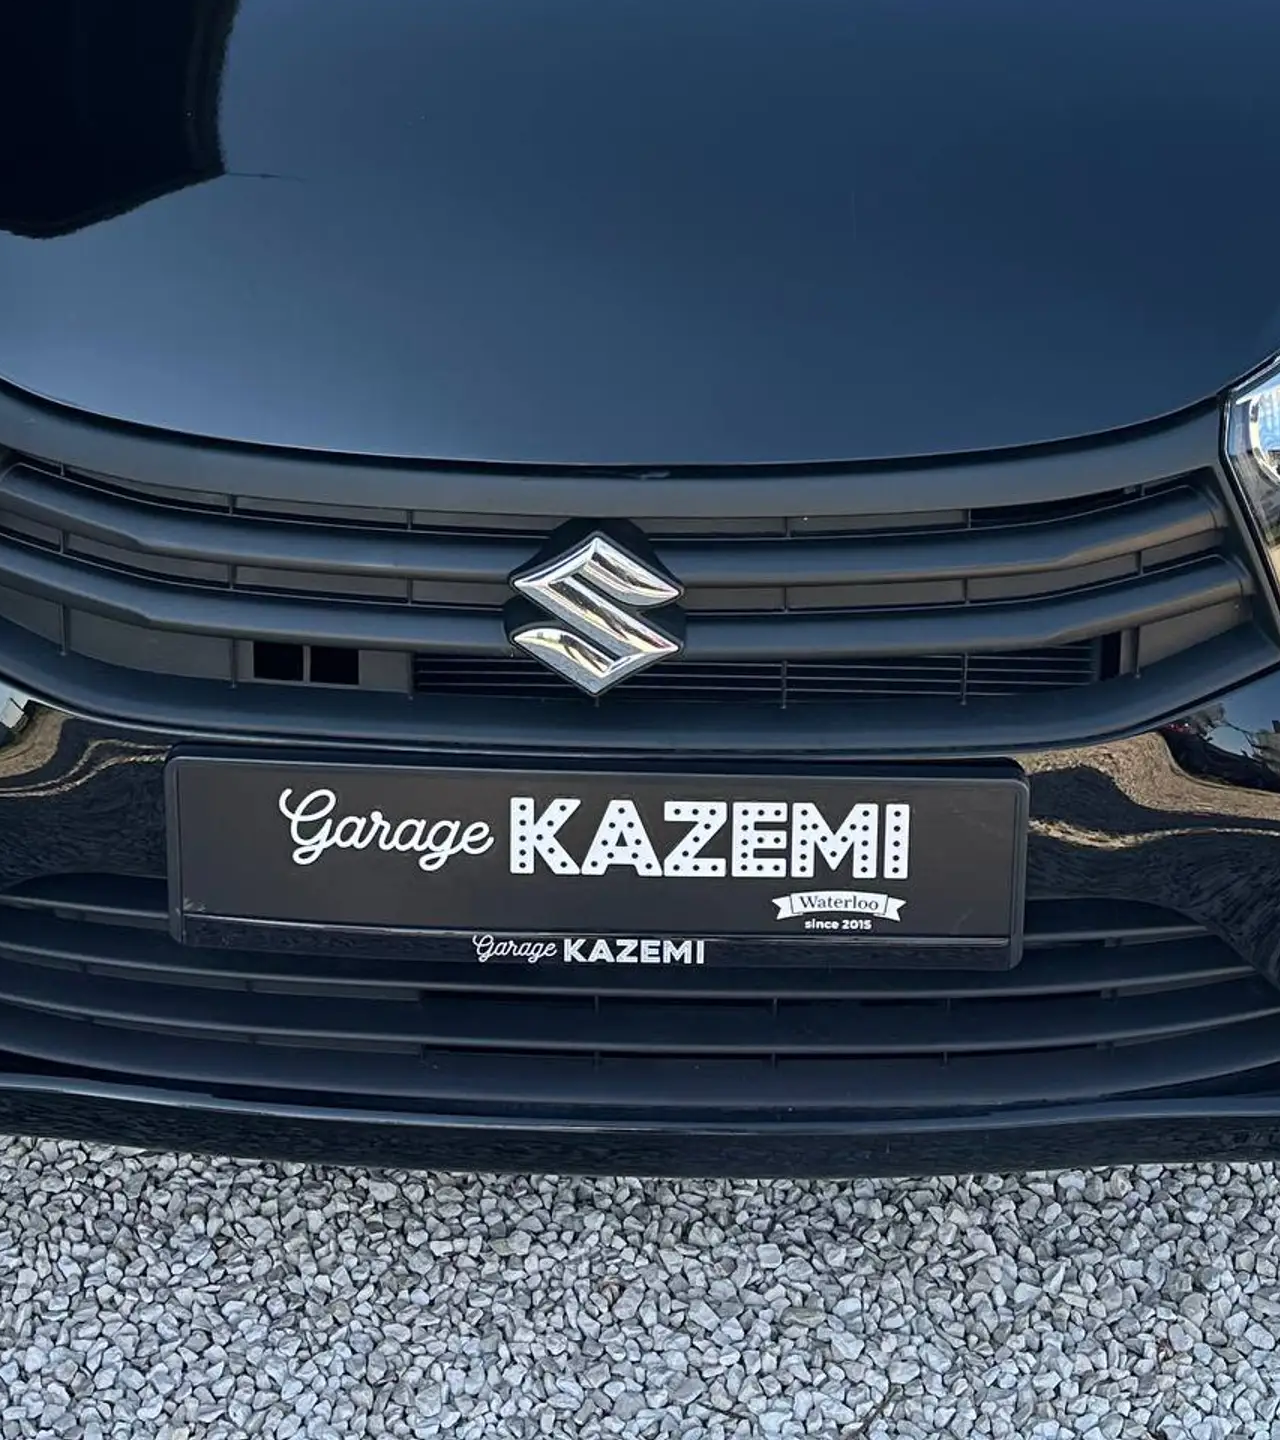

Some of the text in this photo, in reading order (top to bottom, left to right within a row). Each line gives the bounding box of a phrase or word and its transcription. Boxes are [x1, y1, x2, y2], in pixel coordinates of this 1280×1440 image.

[278, 787, 911, 880] Garage KAZEMI
[798, 894, 880, 911] Waterloo
[804, 918, 873, 931] since 2015
[471, 934, 705, 965] Garage KAZEMI
